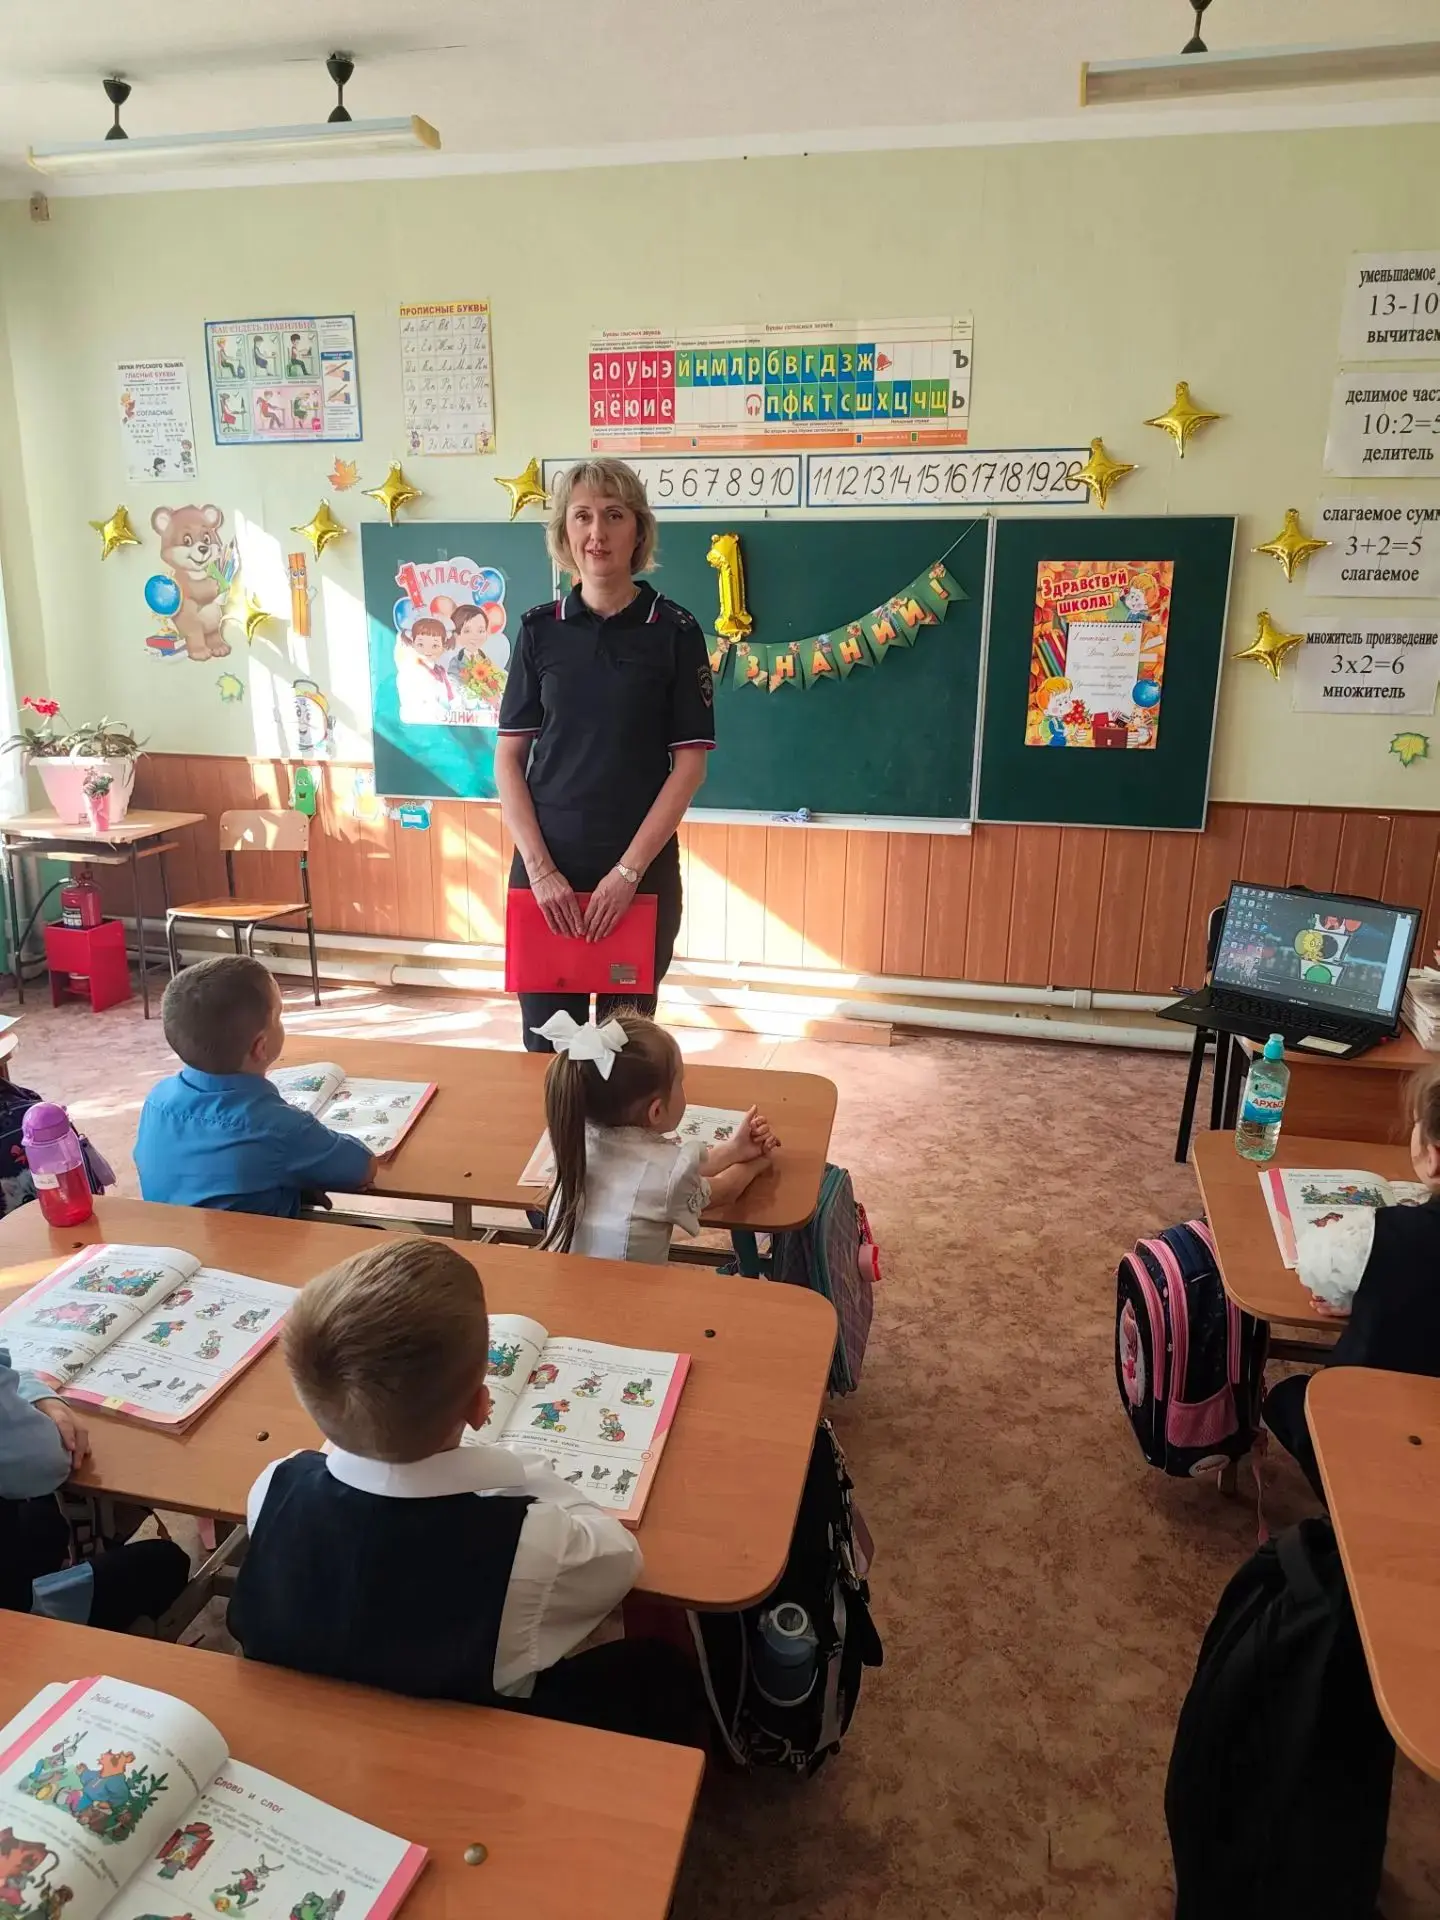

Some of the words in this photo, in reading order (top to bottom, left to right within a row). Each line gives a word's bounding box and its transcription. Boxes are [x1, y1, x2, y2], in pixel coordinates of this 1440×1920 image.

[1358, 267, 1436, 288] уменьшаемое
[400, 304, 454, 316] ПРОПИСНЫЕ
[457, 303, 488, 313] БУКВЫ
[1345, 389, 1408, 406] делимое
[1362, 413, 1440, 435] 10:2=5
[1362, 447, 1434, 463] делитель
[658, 469, 675, 497] 5
[682, 468, 698, 497] 6
[704, 467, 720, 497] 7
[726, 467, 742, 497] 8
[748, 467, 765, 497] 9
[769, 467, 795, 496] 10
[836, 465, 860, 495] 12
[863, 465, 885, 495] 13
[890, 465, 912, 495] 14
[917, 464, 941, 494] 15
[944, 463, 967, 494] 16
[971, 462, 998, 493] 17
[999, 462, 1022, 493] 18
[1026, 461, 1049, 492] 19
[1323, 507, 1402, 521] слагаемое
[1345, 535, 1423, 556] 3+2=5
[1041, 569, 1128, 597] ЗДРАВСТВУЙ
[1341, 568, 1420, 581] слагаемое
[398, 564, 423, 608] 1
[419, 566, 490, 595] КЛАСС!
[1058, 595, 1113, 615] ШКОЛА!
[1306, 632, 1363, 645] множитель
[1365, 632, 1439, 649] произведение
[1323, 685, 1406, 699] множитель
[214, 1776, 244, 1795] Слово
[248, 1792, 256, 1801] и
[260, 1798, 286, 1814] слог
